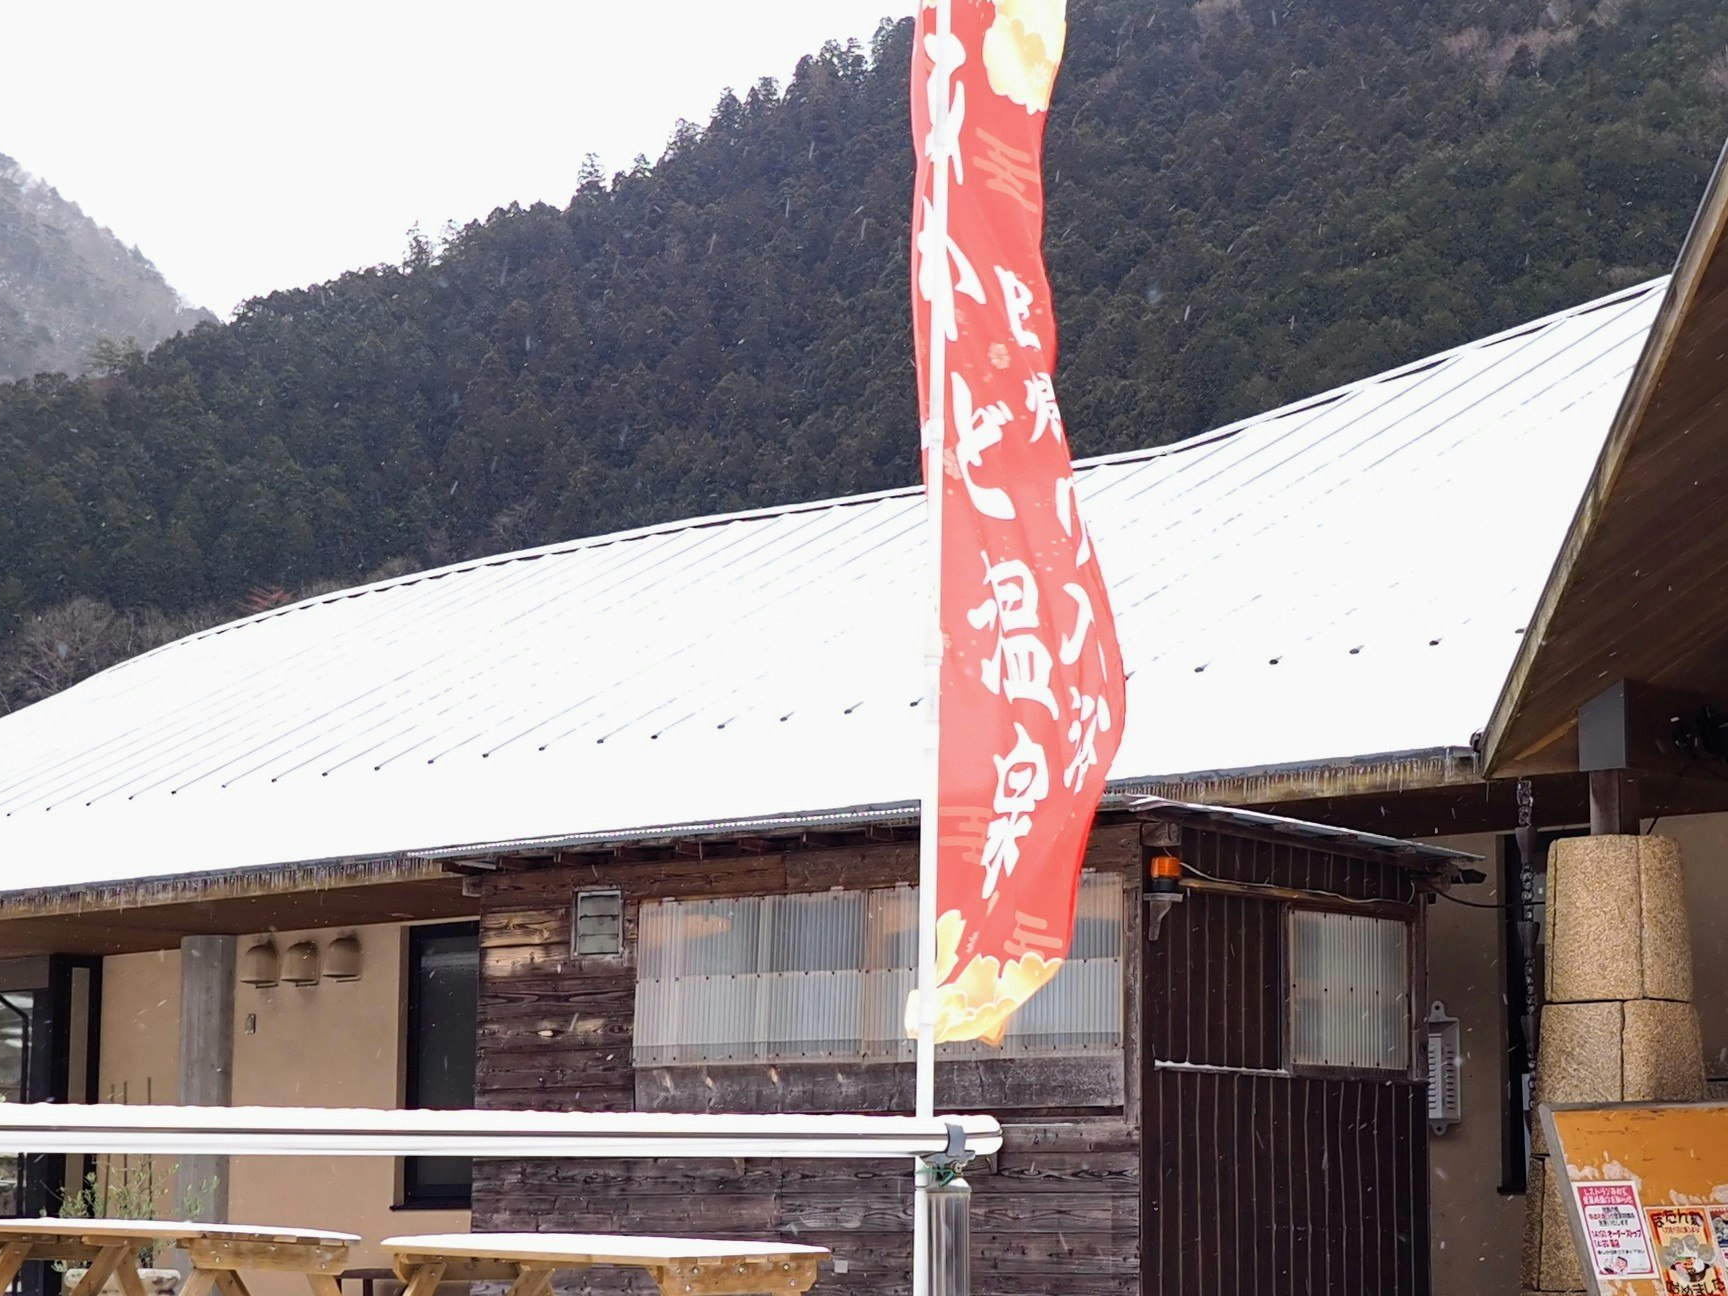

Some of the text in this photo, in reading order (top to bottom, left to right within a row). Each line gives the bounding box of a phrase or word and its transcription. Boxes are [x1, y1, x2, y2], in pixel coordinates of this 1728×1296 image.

[917, 32, 1060, 900] みかど温泉
